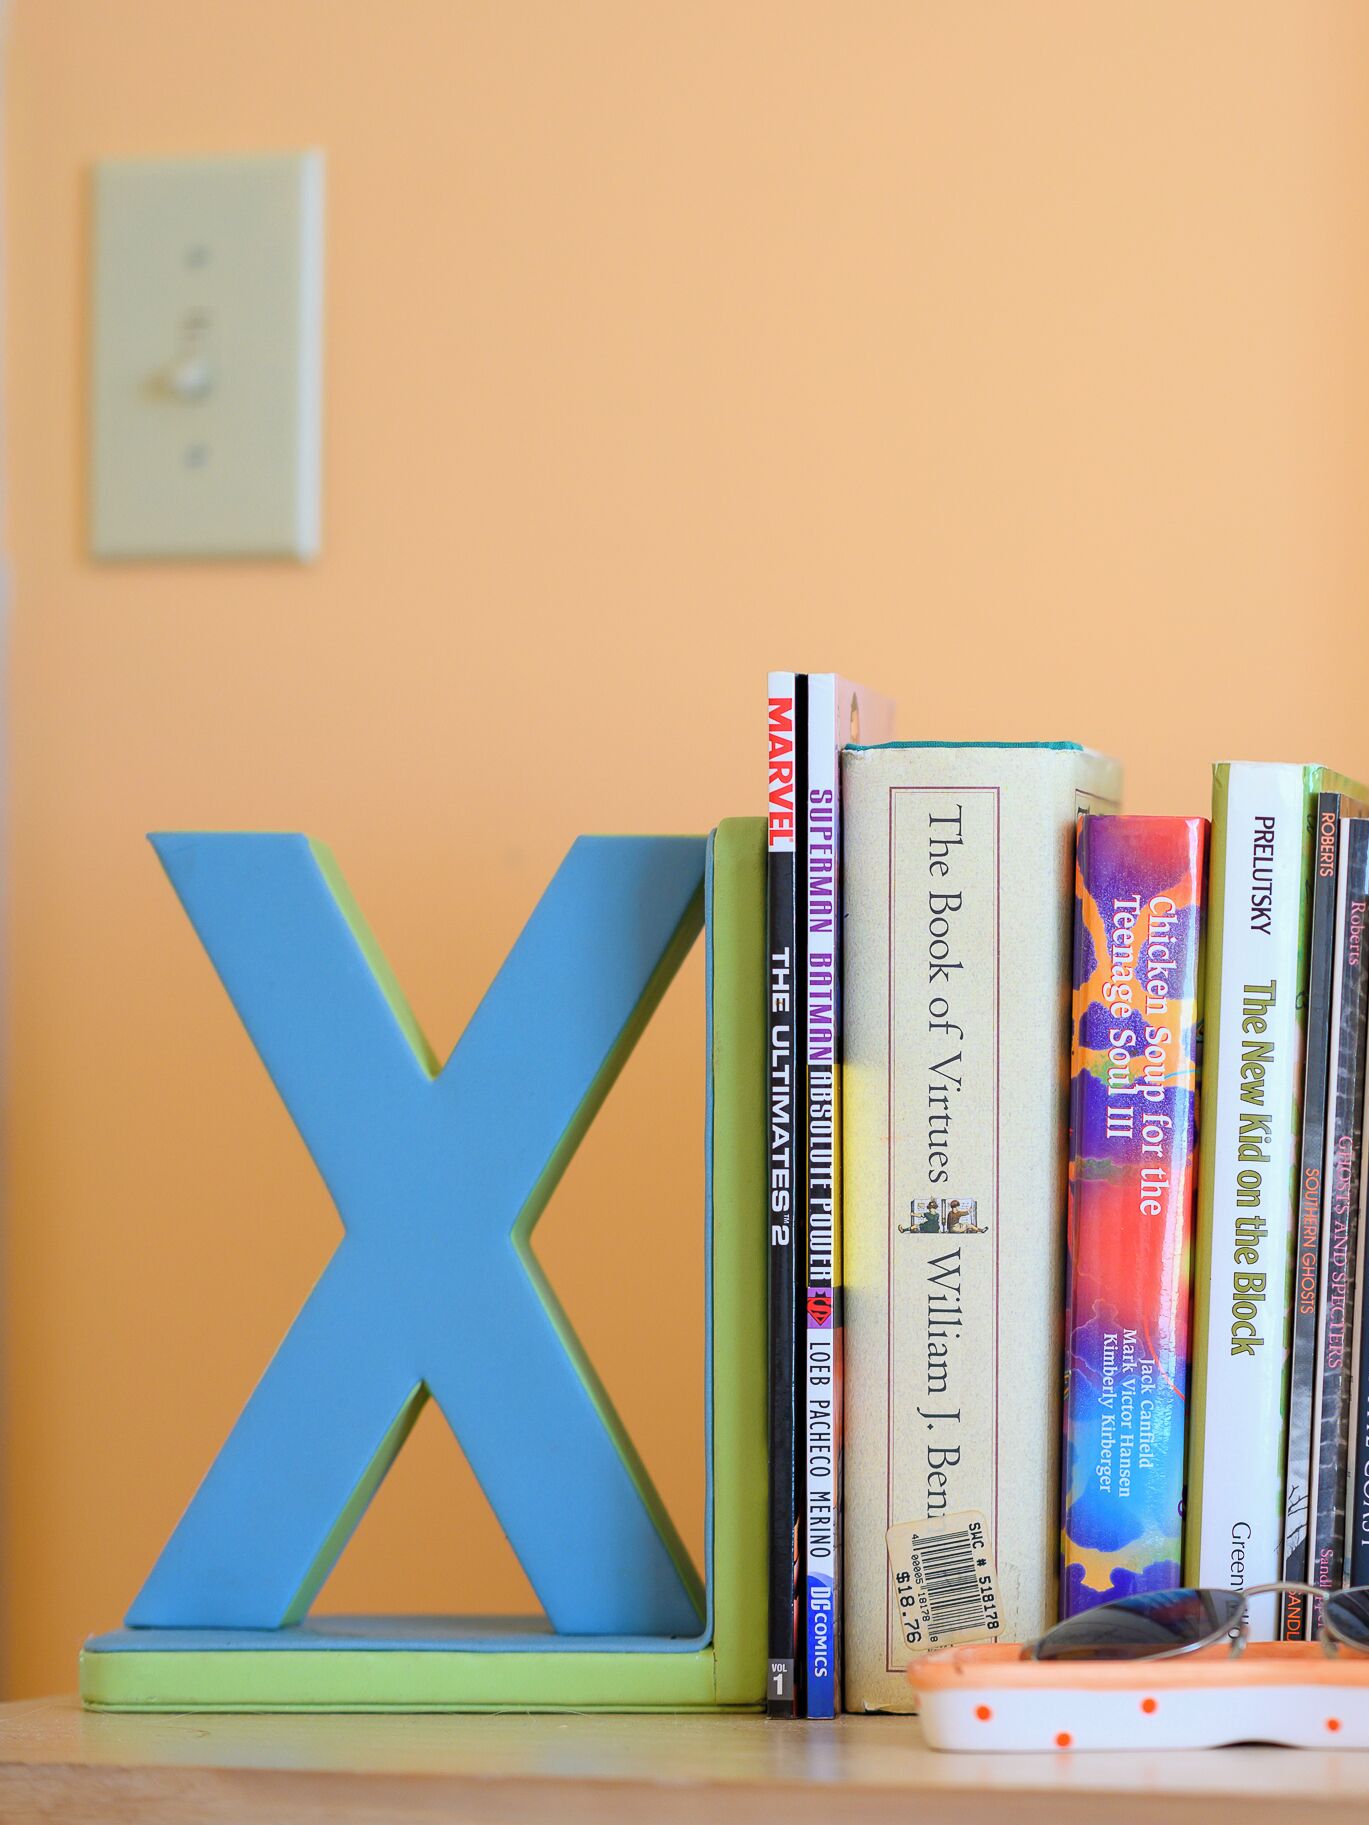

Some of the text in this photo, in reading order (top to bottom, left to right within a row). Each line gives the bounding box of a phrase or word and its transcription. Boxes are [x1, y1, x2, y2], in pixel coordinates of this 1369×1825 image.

[768, 698, 794, 846] MARVEL
[1250, 816, 1276, 936] PRELUTSKY
[1319, 811, 1336, 877] ROBERTS
[772, 947, 790, 1012] THE
[928, 804, 964, 1184] The Book of Virtues
[1347, 900, 1367, 966] Roberts
[809, 789, 832, 1281] SUPERMAN BATMAN ABSOLUTE POWER
[1102, 894, 1141, 1140] Teenage Soul III
[1134, 895, 1177, 1217] Chicken Soup for the
[1230, 979, 1277, 1356] The New Kid on the Block
[772, 1225, 790, 1246] 2
[1300, 1167, 1320, 1315] SOUTHERN GHOSTS
[1327, 1135, 1354, 1370] GHOSTS AND SPECTERS
[926, 1246, 963, 1396] William
[809, 1342, 831, 1558] LOEB PACHECO MERINO
[916, 1406, 961, 1431] J.
[1095, 1332, 1118, 1494] Kimberly Kirberger
[1118, 1327, 1138, 1498] Mark Victor Hansen
[1138, 1357, 1156, 1469] Jack Canfield
[811, 1586, 832, 1678] DC COMICS
[896, 1571, 922, 1644] $18.76
[968, 1522, 985, 1549] SWC
[979, 1575, 1000, 1630] 518178
[771, 1664, 787, 1673] VOL
[773, 1674, 784, 1695] 1
